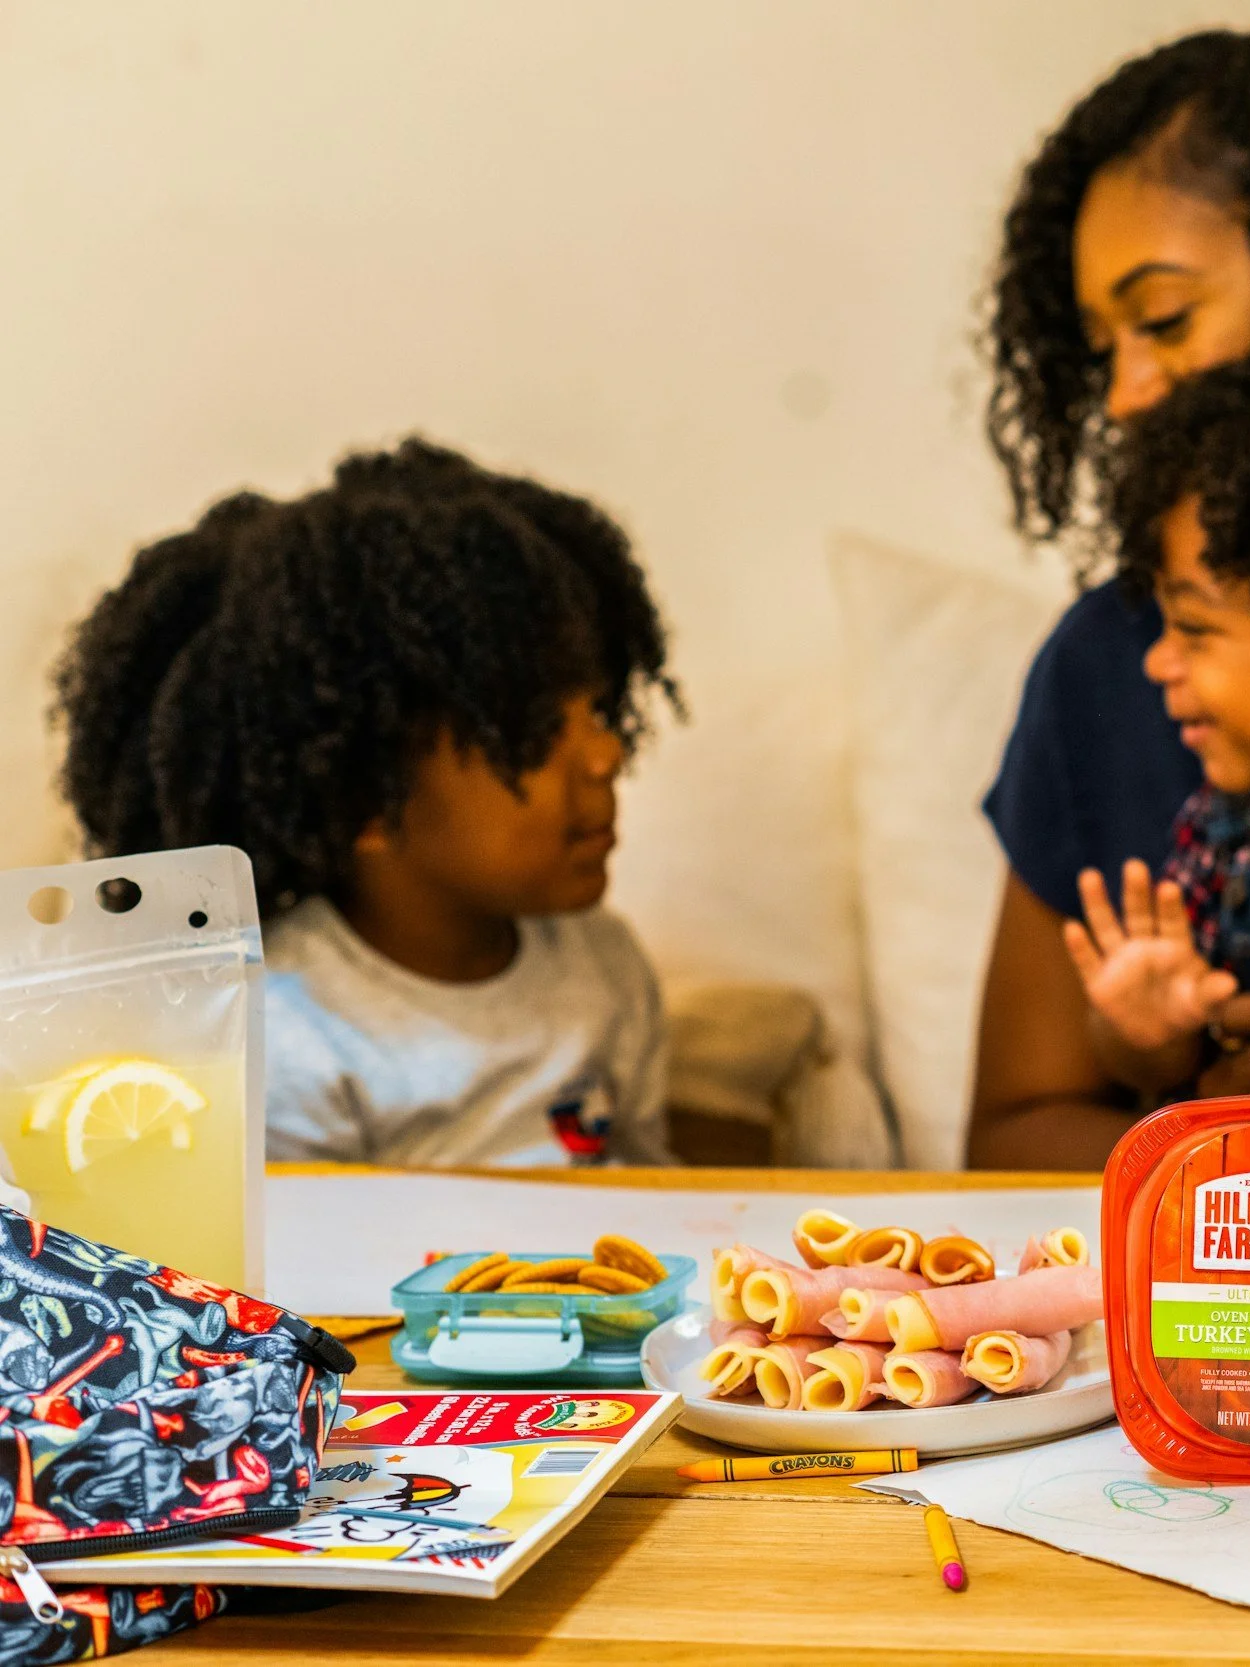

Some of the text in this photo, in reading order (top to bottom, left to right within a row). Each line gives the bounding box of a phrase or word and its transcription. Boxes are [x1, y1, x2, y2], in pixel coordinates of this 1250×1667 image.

[1211, 1311, 1249, 1323] OVEN
[540, 1395, 570, 1404] We
[516, 1405, 546, 1421] Know
[1218, 1411, 1234, 1426] NET
[769, 1454, 856, 1474] CRAYONS
